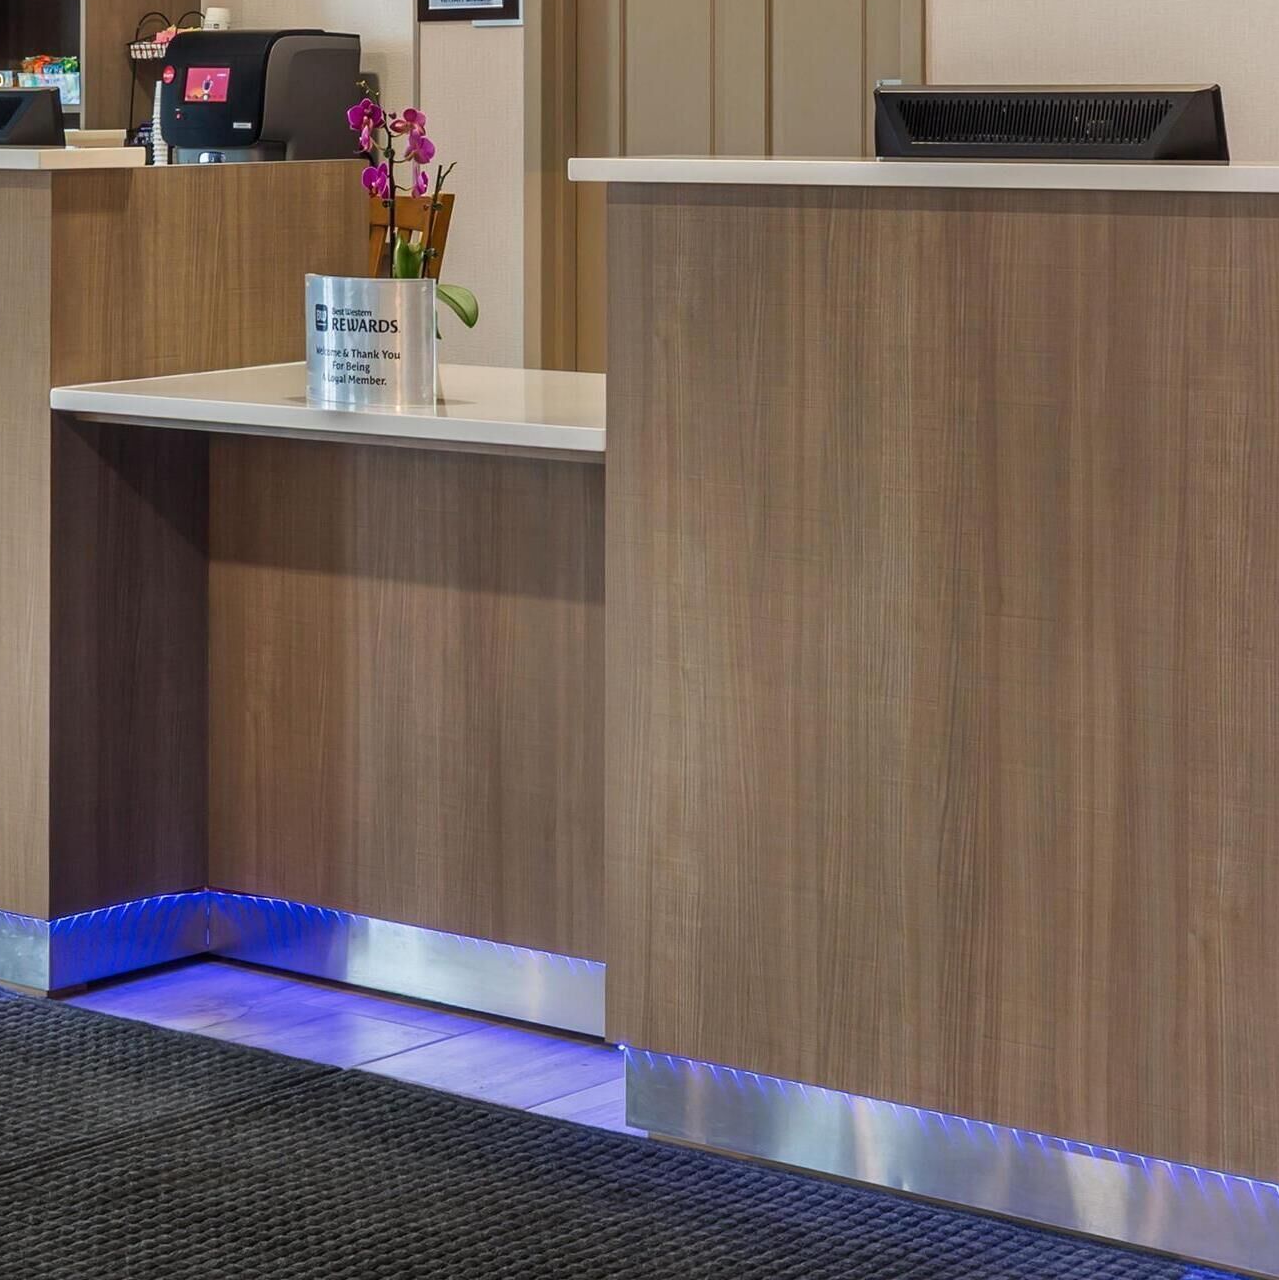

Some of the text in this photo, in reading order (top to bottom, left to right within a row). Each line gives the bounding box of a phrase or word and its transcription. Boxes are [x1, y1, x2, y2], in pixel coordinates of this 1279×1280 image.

[343, 349, 348, 357] &
[351, 349, 379, 359] Thank
[382, 350, 400, 359] You
[333, 361, 370, 374] For Being
[348, 376, 386, 385] Member.
